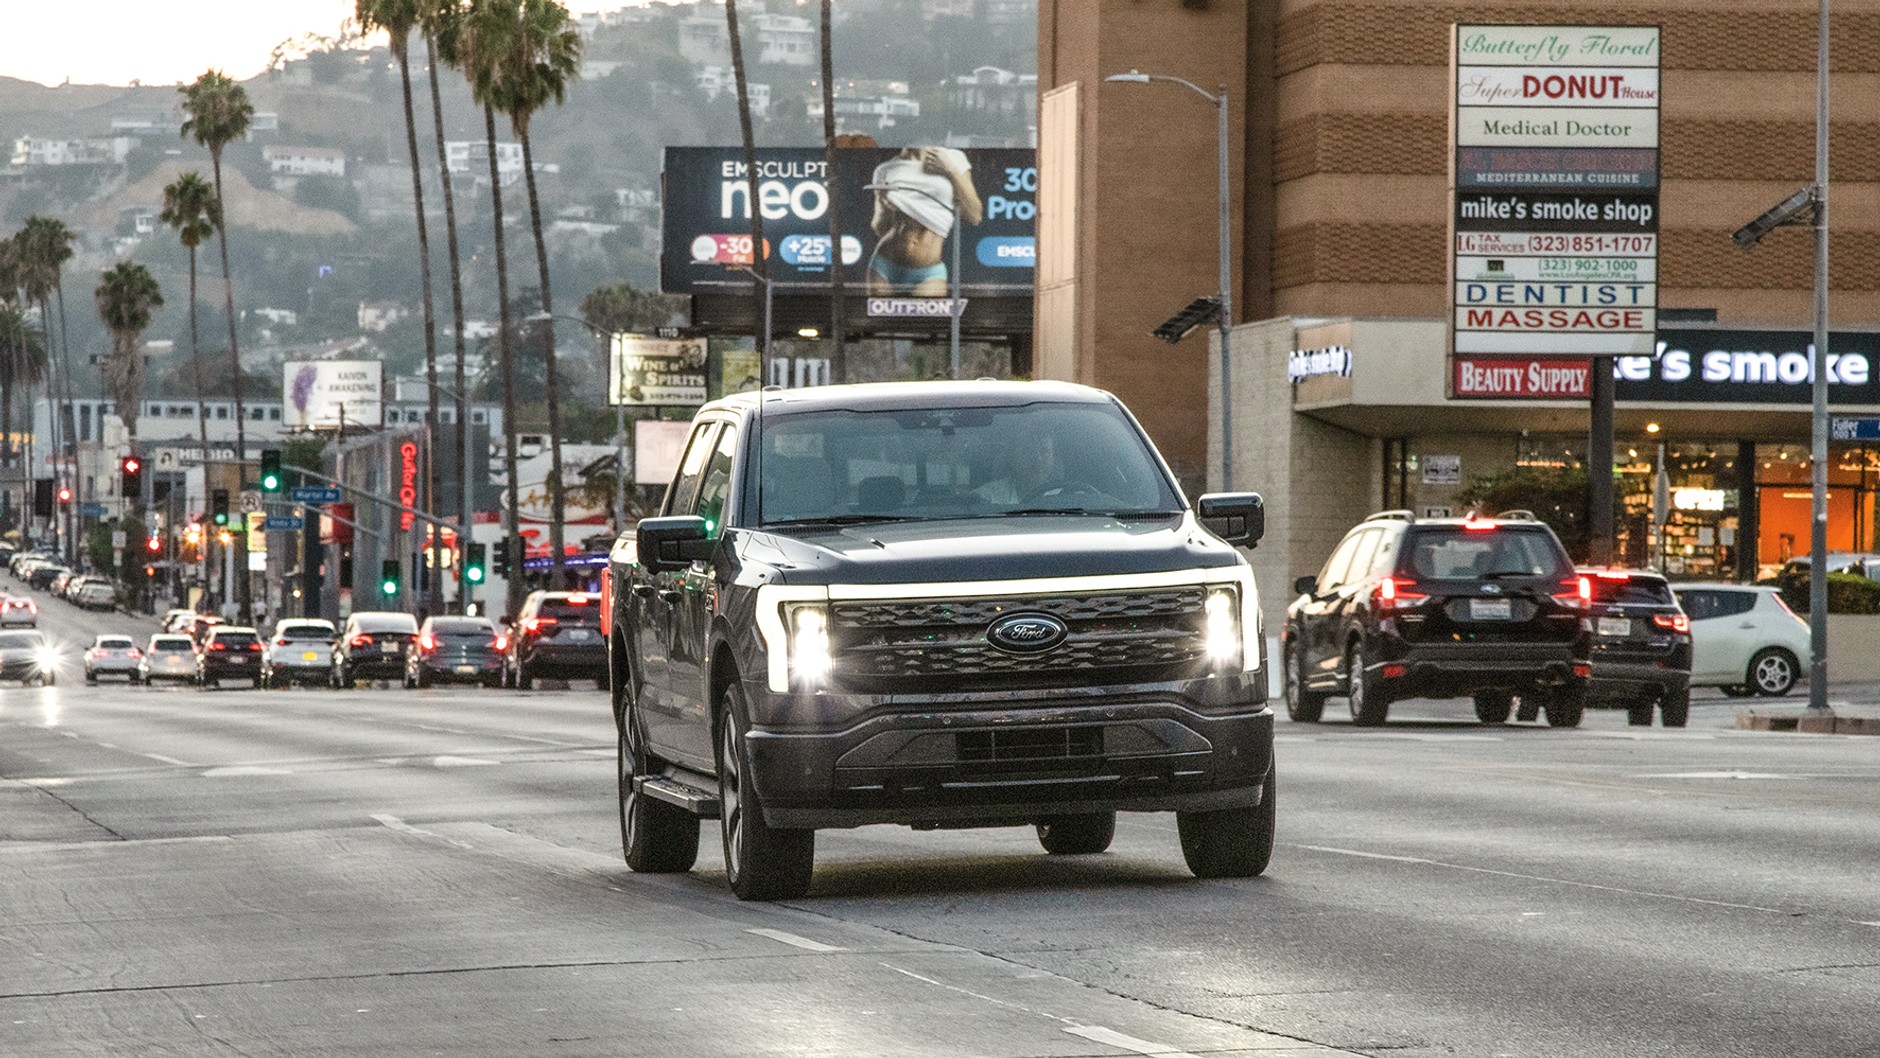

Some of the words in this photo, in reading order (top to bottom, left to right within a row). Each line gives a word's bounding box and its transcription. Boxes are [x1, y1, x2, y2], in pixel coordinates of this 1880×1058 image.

[1462, 34, 1570, 62] Butterfly
[1580, 35, 1656, 56] Floral
[1460, 74, 1522, 103] Super
[1522, 75, 1624, 99] DONUT
[1620, 87, 1657, 99] House
[1483, 120, 1559, 136] Medical
[1566, 120, 1631, 136] Doctor
[1476, 172, 1584, 184] MEDITERRANEAN
[1588, 173, 1639, 184] CUISINE
[721, 180, 829, 220] neo
[1461, 196, 1527, 219] mike's
[1532, 198, 1598, 220] smoke
[1603, 199, 1652, 226] shop
[1478, 234, 1500, 242] TAX
[1528, 236, 1570, 253] (323)
[1573, 237, 1653, 252] 851-1707
[1477, 243, 1525, 252] SERVICES
[1538, 259, 1571, 272] (323)
[1575, 259, 1638, 271] 902-1000
[1466, 284, 1644, 304] DENTIST
[1467, 310, 1644, 328] MASSAGE
[1702, 344, 1869, 384] smoke
[645, 372, 705, 386] SPIRITS
[1461, 362, 1523, 392] BEAUTY
[1528, 363, 1587, 393] SUPPLY
[1011, 624, 1046, 639] Ford
